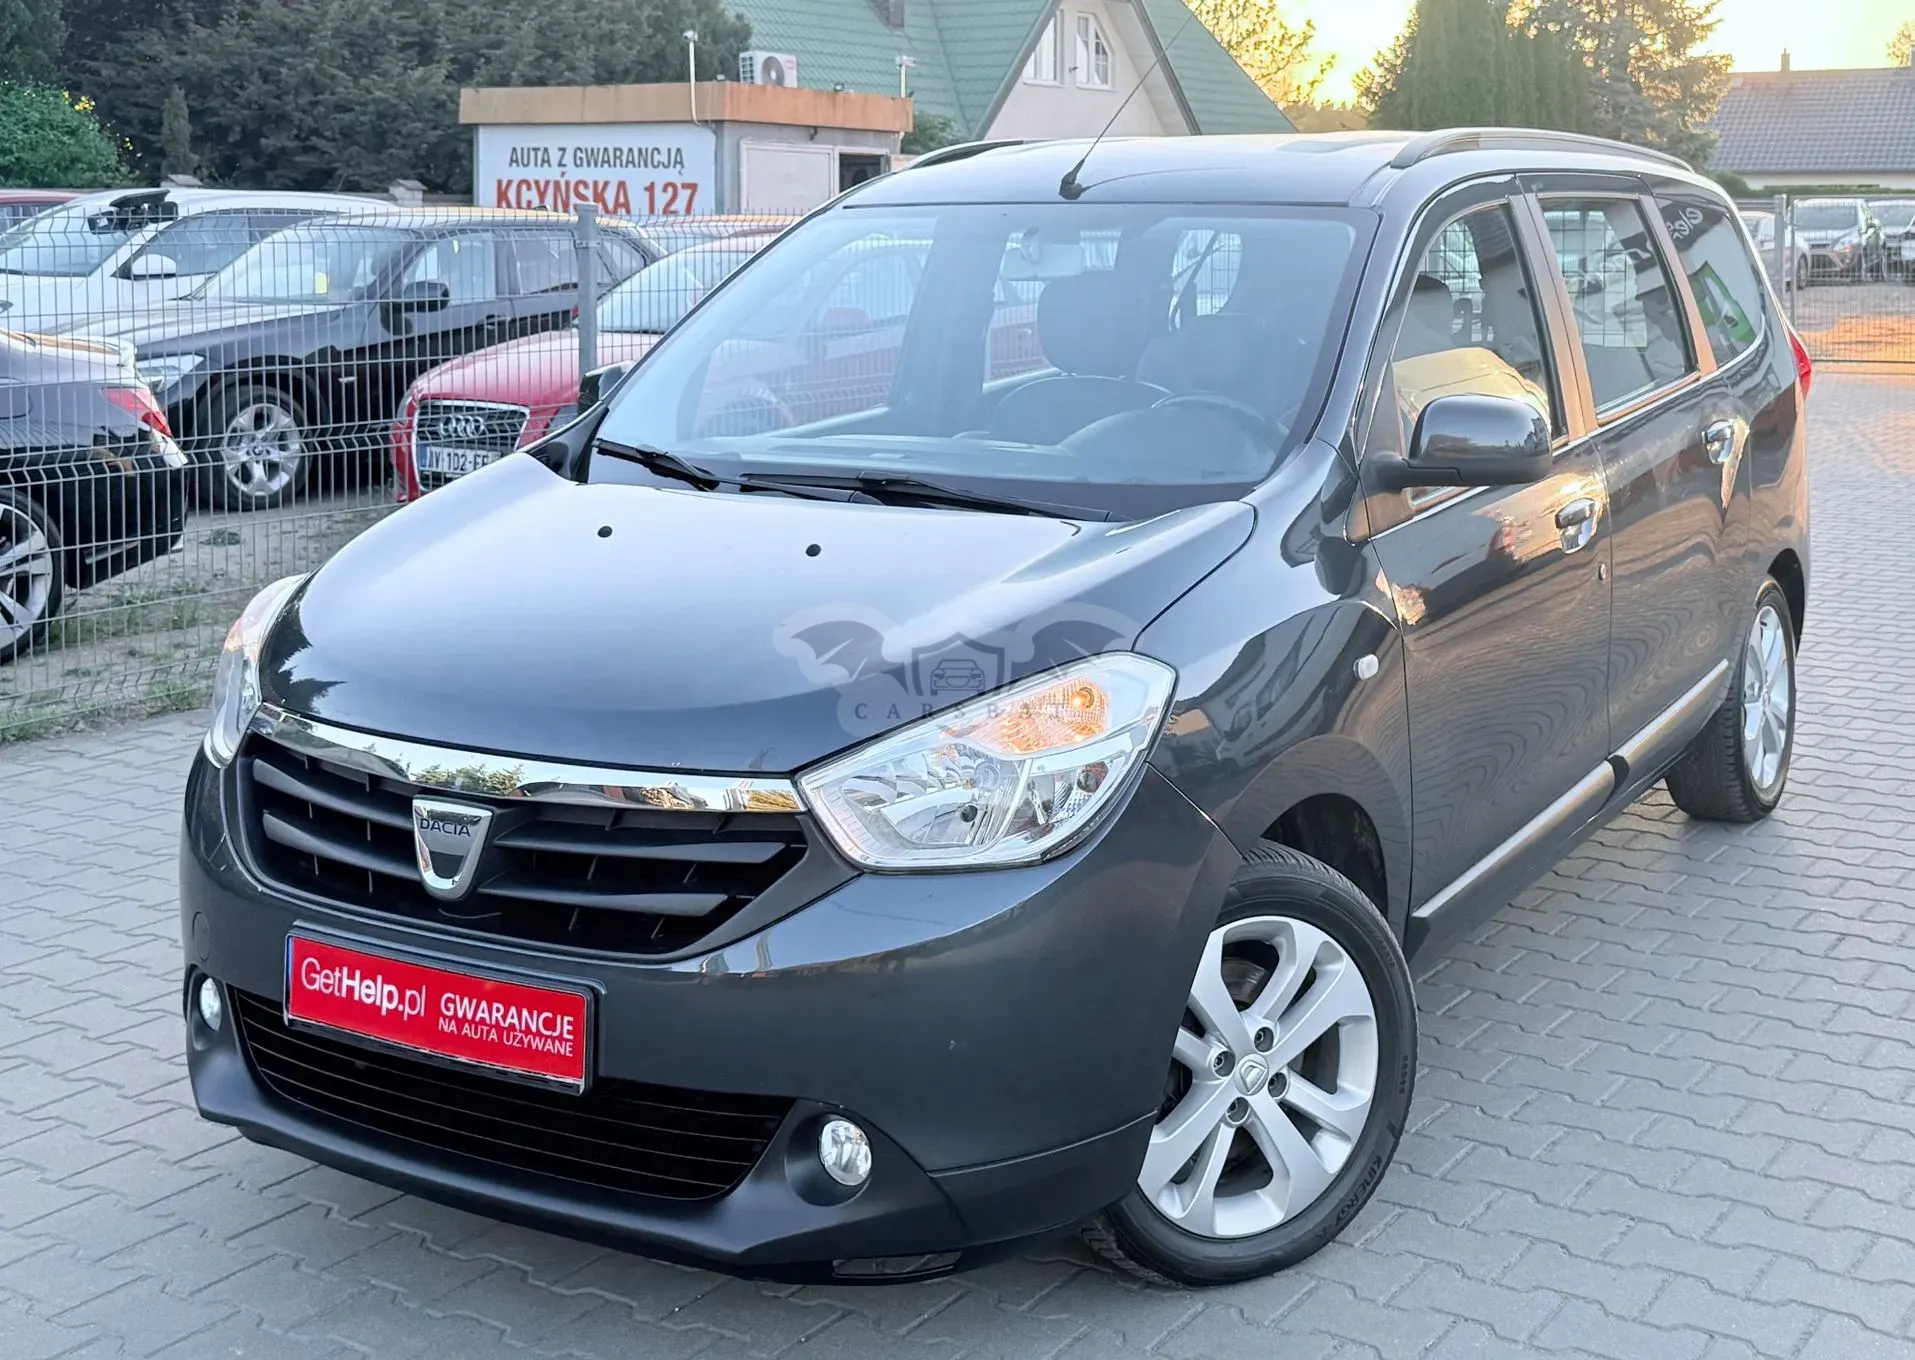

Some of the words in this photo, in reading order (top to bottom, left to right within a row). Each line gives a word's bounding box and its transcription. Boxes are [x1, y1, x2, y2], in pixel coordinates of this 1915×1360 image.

[509, 147, 552, 168] AUTA
[557, 147, 568, 168] Z
[573, 147, 685, 176] GWARANCJĄ
[496, 171, 632, 216] KCYŃSKA
[643, 181, 699, 216] 127
[420, 818, 471, 837] DACIA
[300, 956, 426, 1022] GetHelp.pl
[438, 1016, 458, 1036] NA
[462, 1022, 499, 1043] AUTA
[503, 1028, 574, 1057] UŻYWANE
[440, 993, 574, 1040] GWARANCJE
[1335, 1154, 1384, 1226] KINERGY
